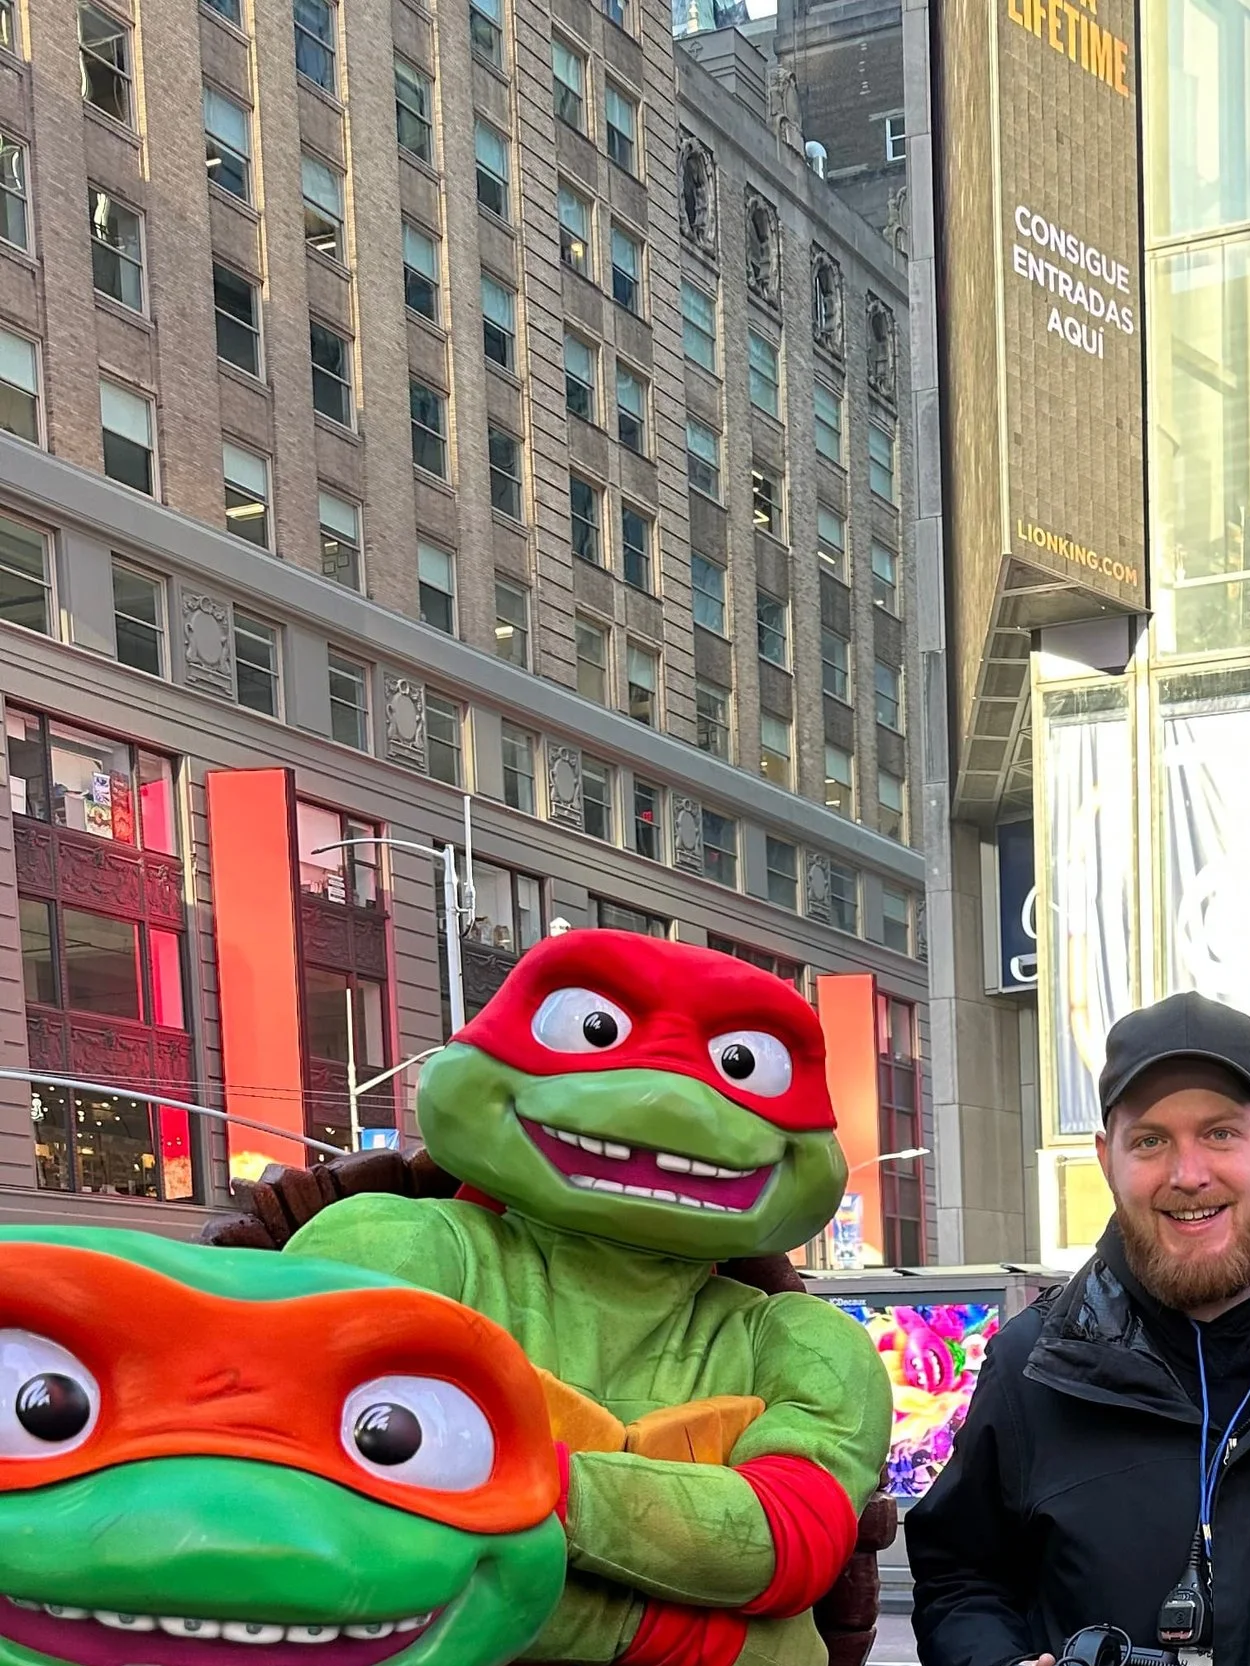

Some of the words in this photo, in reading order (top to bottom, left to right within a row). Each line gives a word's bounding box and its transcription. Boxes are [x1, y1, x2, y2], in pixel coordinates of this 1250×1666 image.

[1013, 243, 1134, 335] ENTRADAS
[1015, 205, 1130, 294] CONSIGUE
[1017, 519, 1138, 587] LIONKING.COM
